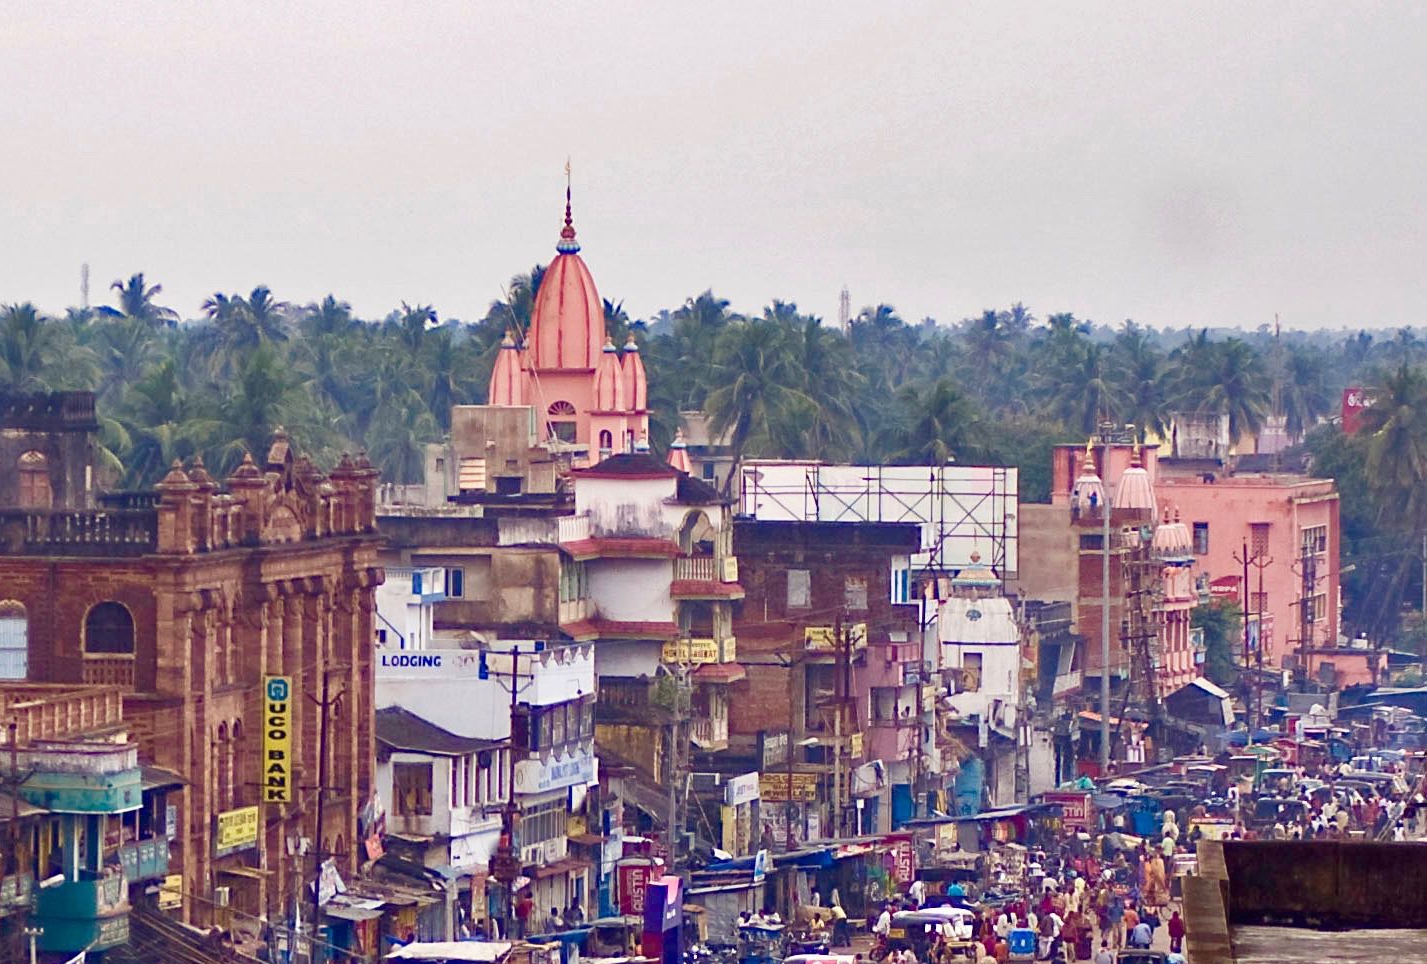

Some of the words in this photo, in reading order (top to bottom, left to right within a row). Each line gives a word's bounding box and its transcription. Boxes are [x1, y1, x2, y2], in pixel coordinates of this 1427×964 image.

[382, 655, 441, 667] LODGING
[268, 703, 286, 740] UCO
[268, 750, 286, 800] BANK
[899, 841, 910, 881] AUSTIN
[632, 869, 644, 912] AUSTIN
